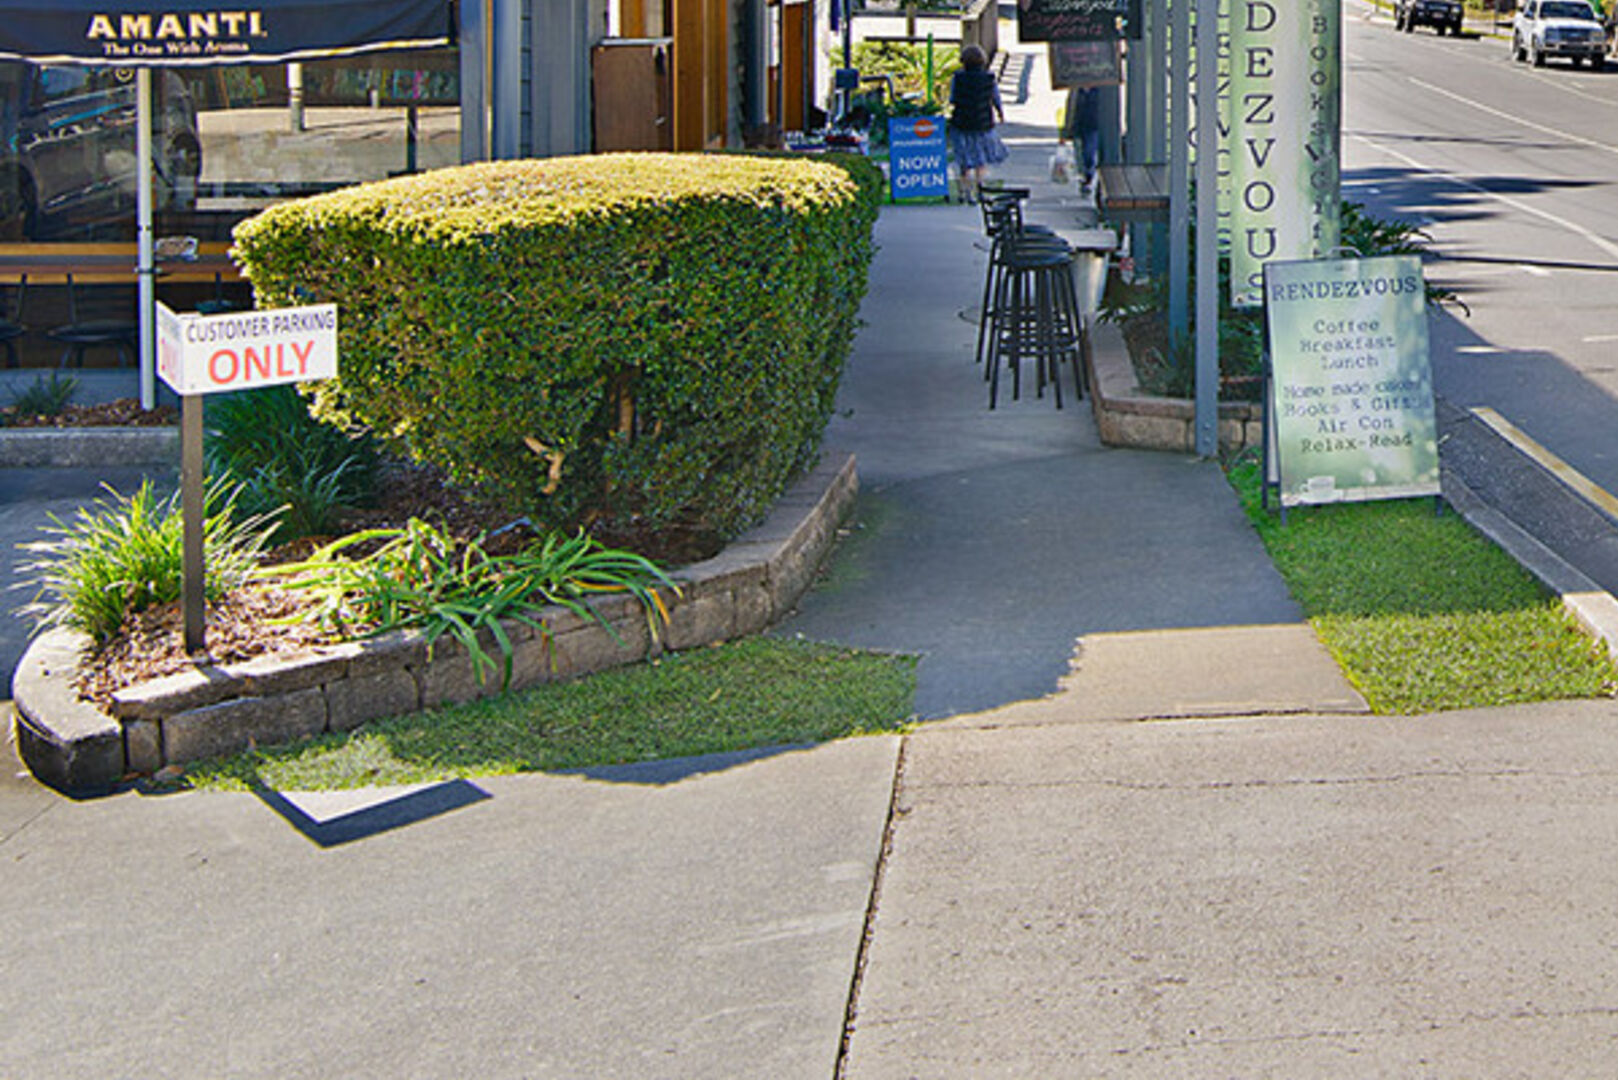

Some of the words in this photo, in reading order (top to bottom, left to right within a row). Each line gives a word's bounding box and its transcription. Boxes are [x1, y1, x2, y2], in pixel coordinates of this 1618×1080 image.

[86, 11, 263, 39] AMANTI
[104, 42, 130, 55] The
[132, 42, 163, 55] One
[899, 155, 941, 170] NOW
[896, 173, 945, 189] OPEN
[1271, 276, 1418, 301] RENDEZVOUS
[186, 315, 271, 342] CUSTOMER
[273, 311, 334, 334] PARKING
[1313, 319, 1380, 335] Coffee
[1300, 336, 1396, 353] Breakfast
[208, 340, 315, 385] ONLY
[1320, 354, 1379, 370] Lunch
[1283, 385, 1325, 399] Home
[1283, 401, 1341, 417] Books
[1318, 420, 1347, 433] Air
[1358, 416, 1394, 431] Con
[1301, 431, 1413, 453] Relax-Read
